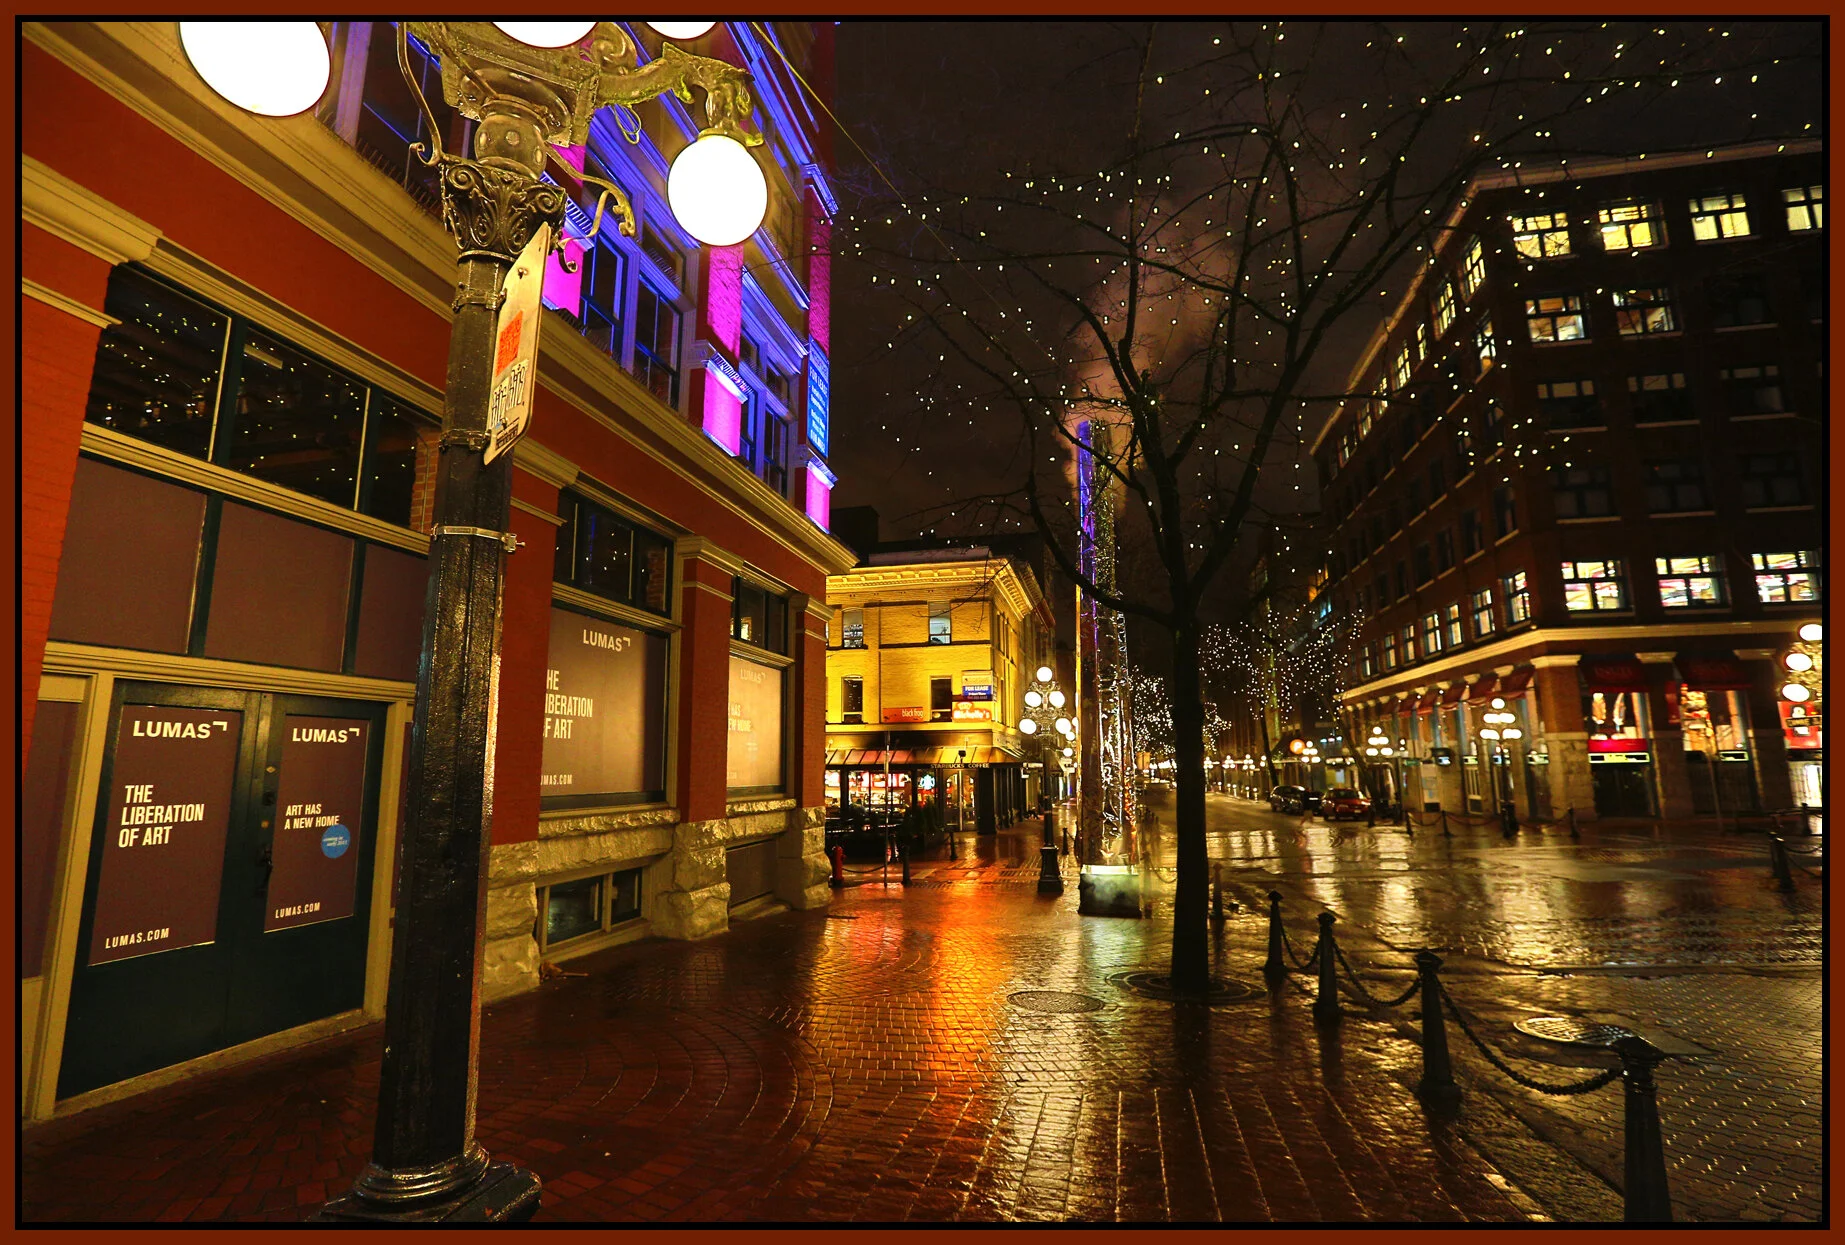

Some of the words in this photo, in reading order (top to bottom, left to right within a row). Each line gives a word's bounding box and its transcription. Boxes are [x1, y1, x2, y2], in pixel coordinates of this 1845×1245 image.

[583, 629, 623, 652] LUMAS
[546, 669, 560, 691] HE
[544, 693, 593, 718] IBERATION
[901, 709, 914, 717] black
[914, 708, 923, 719] frog
[132, 720, 212, 739] LUMAS
[292, 727, 348, 743] LUMAS
[543, 718, 552, 738] F
[553, 718, 574, 739] ART
[540, 774, 573, 786] MAS.COM
[125, 784, 154, 804] THE
[121, 803, 205, 826] LIBERATION
[285, 804, 303, 817] ART
[304, 803, 322, 816] HAS
[284, 818, 291, 830] A
[293, 817, 313, 829] NEW
[315, 815, 340, 828] HOME
[118, 828, 140, 848] OF
[142, 826, 173, 846] ART
[275, 902, 321, 919] LUMAS.COM
[105, 927, 170, 949] LUMAS.COM
